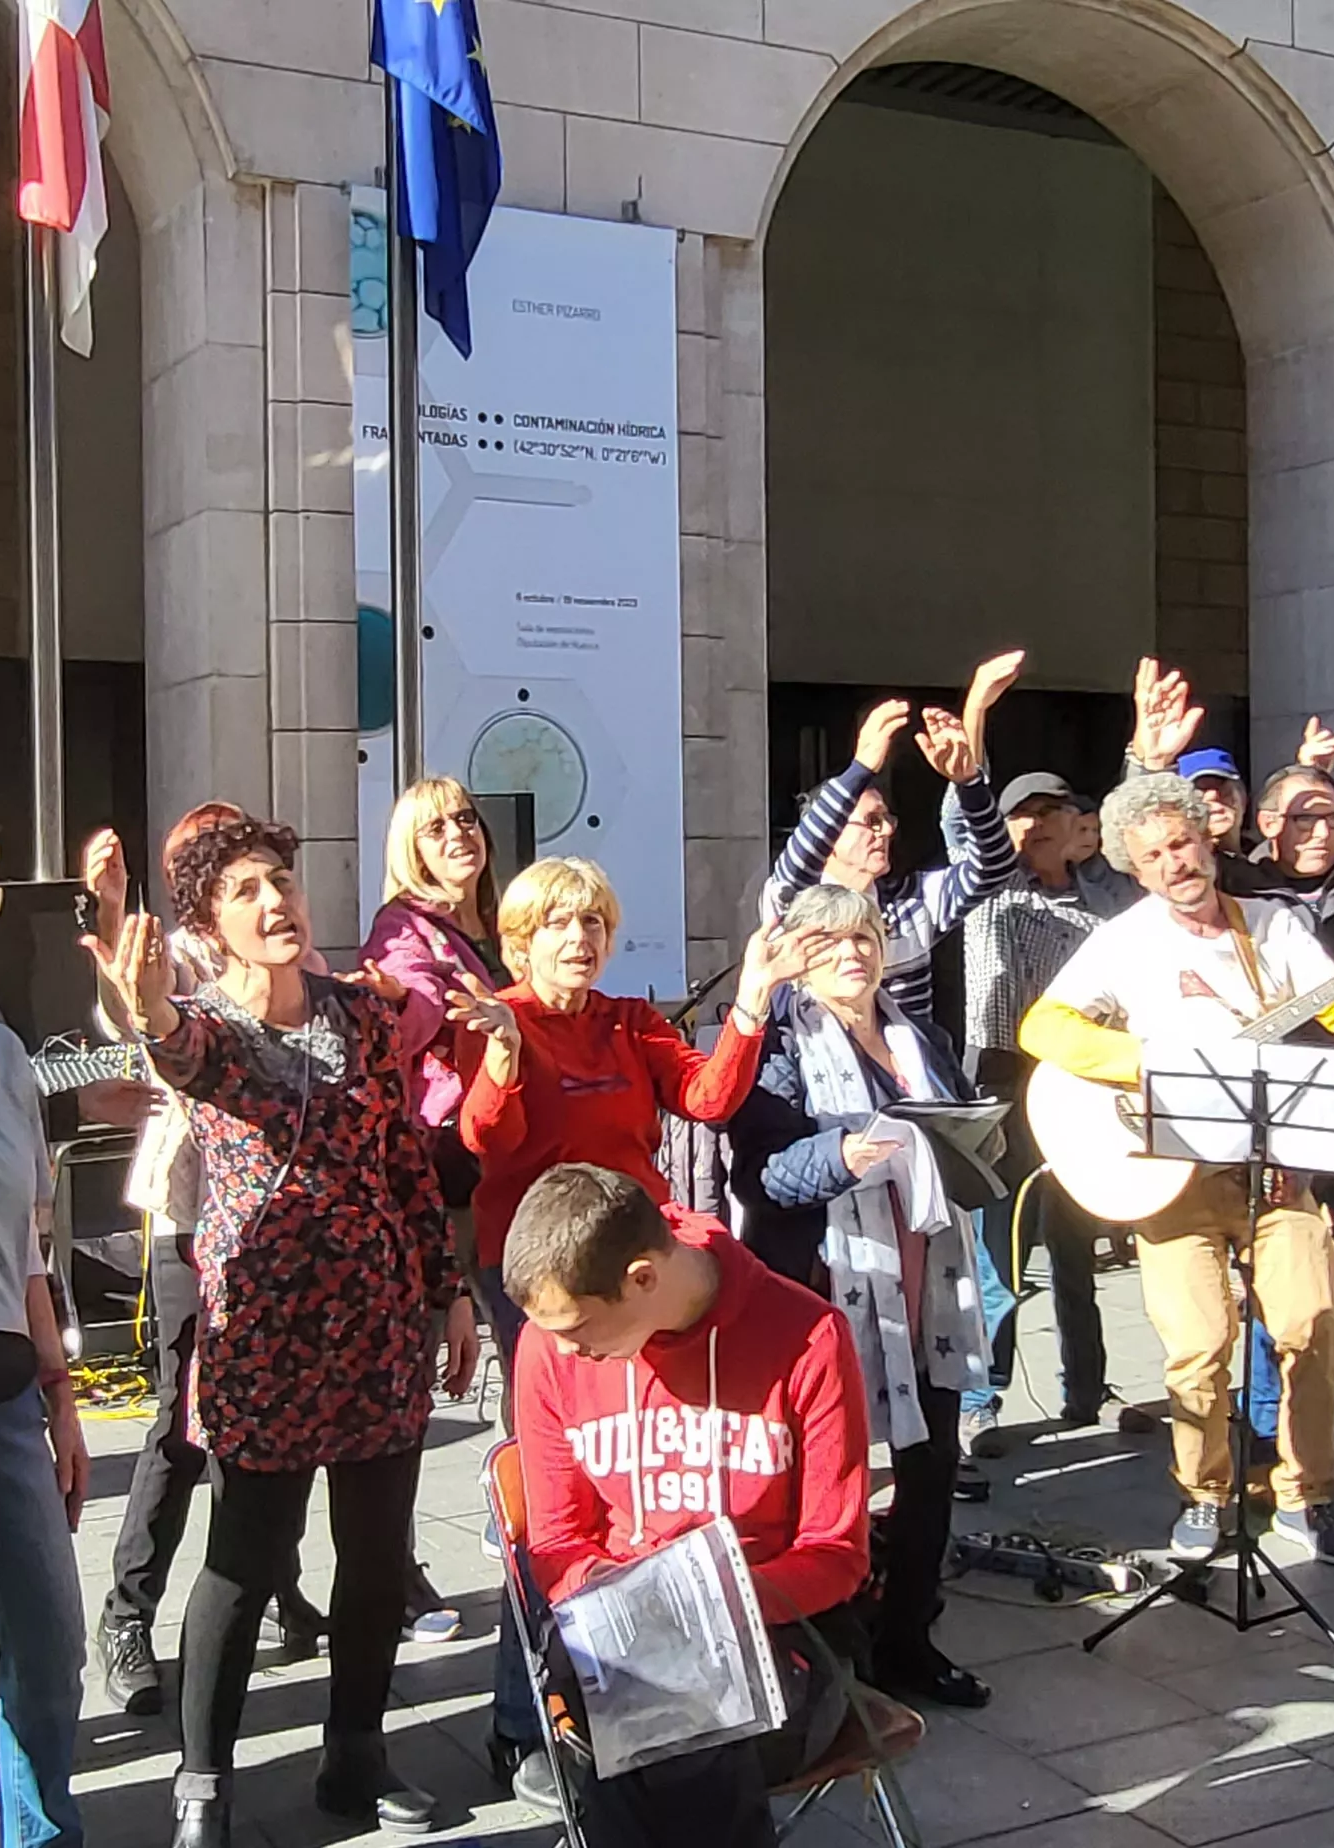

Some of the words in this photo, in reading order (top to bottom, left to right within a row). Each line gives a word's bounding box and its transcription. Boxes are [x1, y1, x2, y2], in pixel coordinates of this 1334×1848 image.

[513, 413, 615, 436] CONTAMINACIÓN
[617, 420, 666, 439] HÍDRICA
[643, 1471, 720, 1514] 1991
